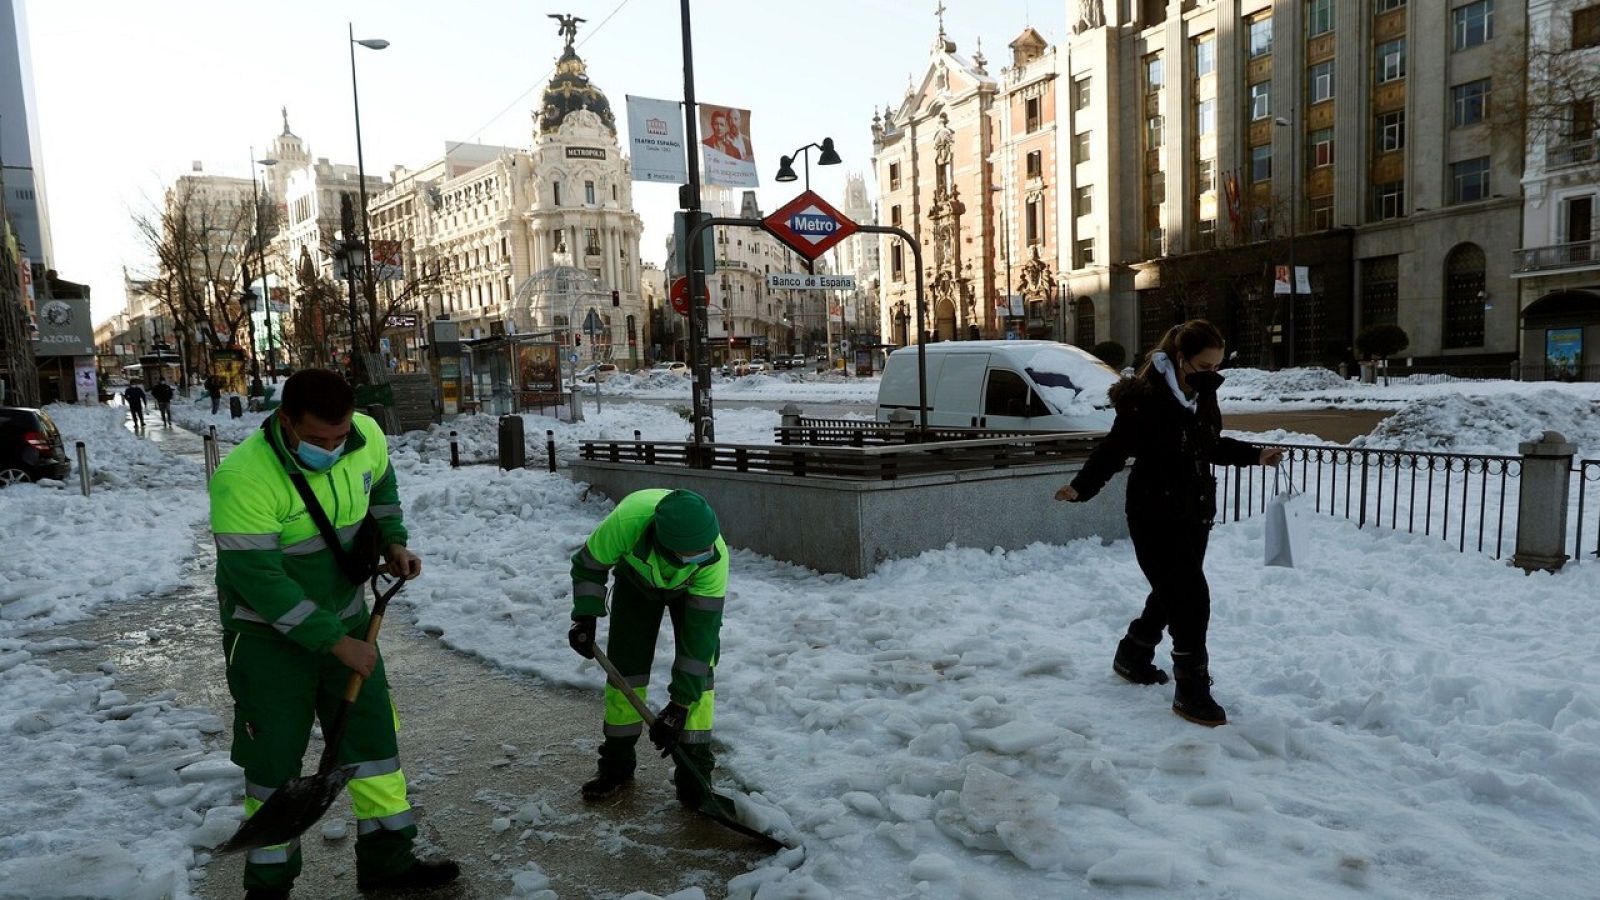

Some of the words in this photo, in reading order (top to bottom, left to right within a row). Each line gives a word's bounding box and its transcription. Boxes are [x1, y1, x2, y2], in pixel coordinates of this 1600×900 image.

[794, 216, 834, 232] Metro
[772, 276, 801, 286] Banco
[804, 278, 815, 286] de
[820, 277, 851, 288] España
[41, 335, 81, 344] AZOTEA
